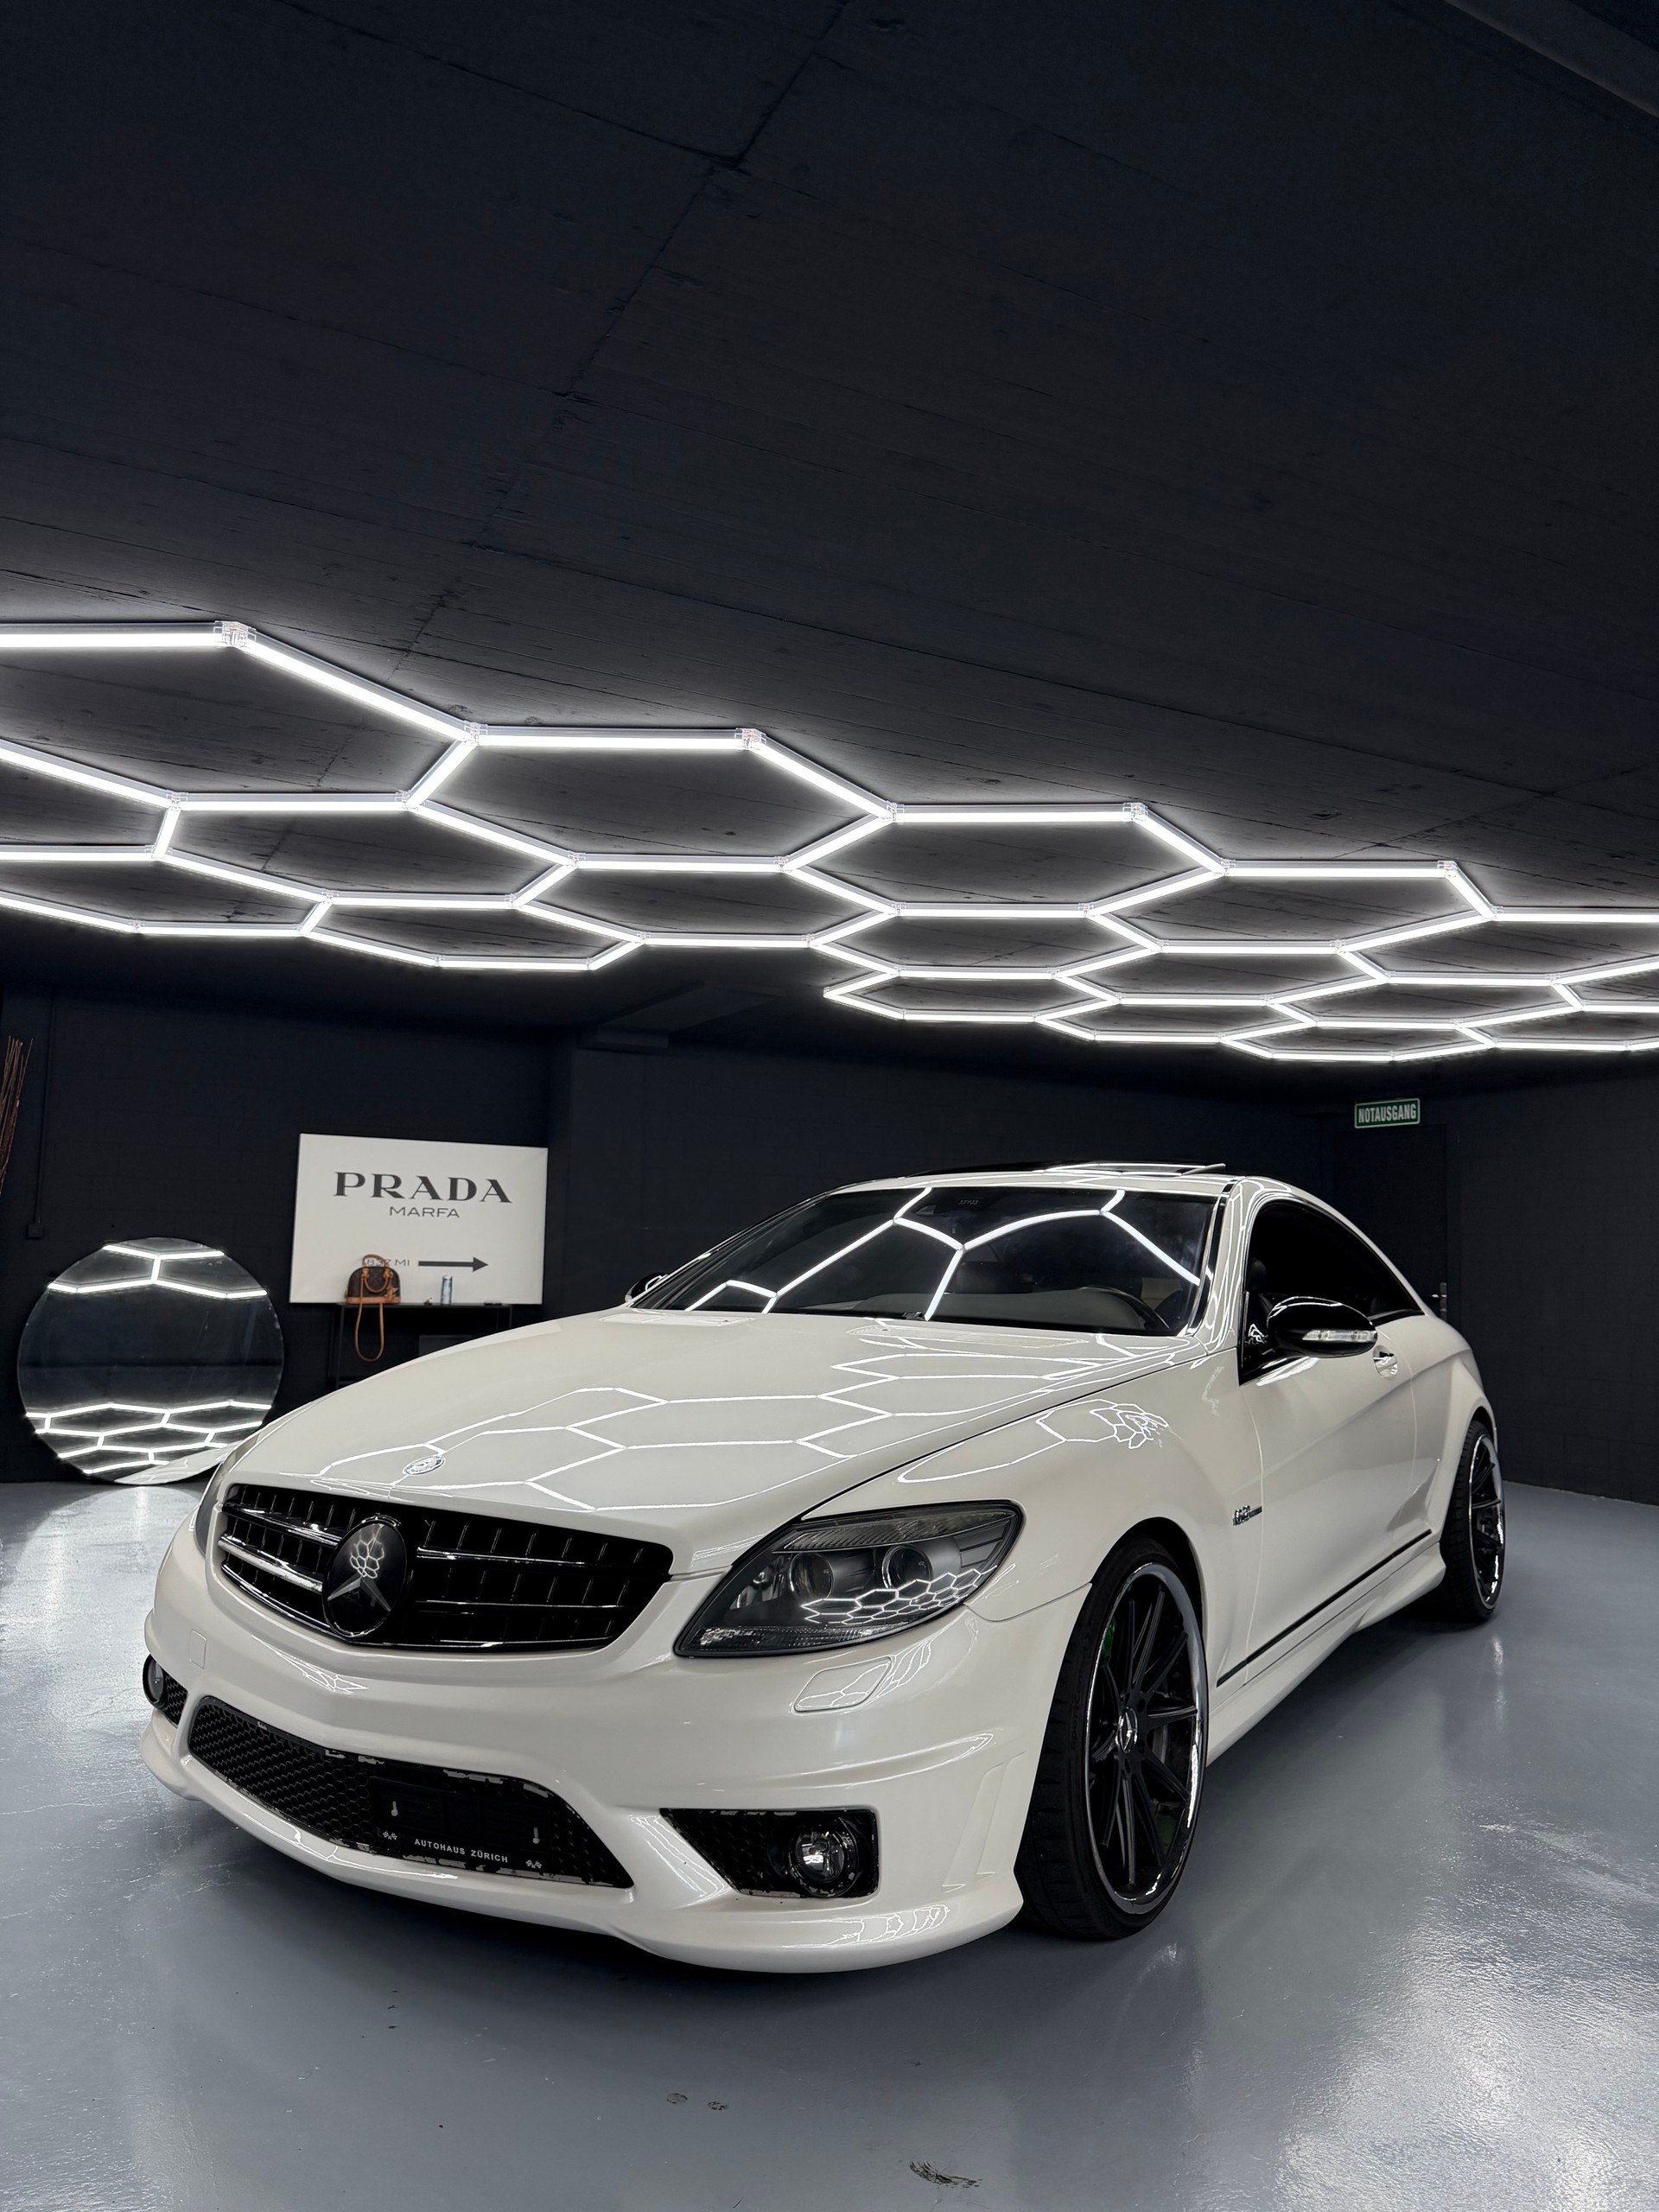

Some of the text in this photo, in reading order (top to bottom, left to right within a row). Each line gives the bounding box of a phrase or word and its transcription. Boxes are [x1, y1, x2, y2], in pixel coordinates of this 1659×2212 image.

[1357, 1103, 1416, 1123] NOTAUSGANG
[333, 1171, 513, 1204] PRADA
[389, 1206, 460, 1218] MARFA
[414, 1838, 509, 1863] AUTOHAUS ZÜRICH
